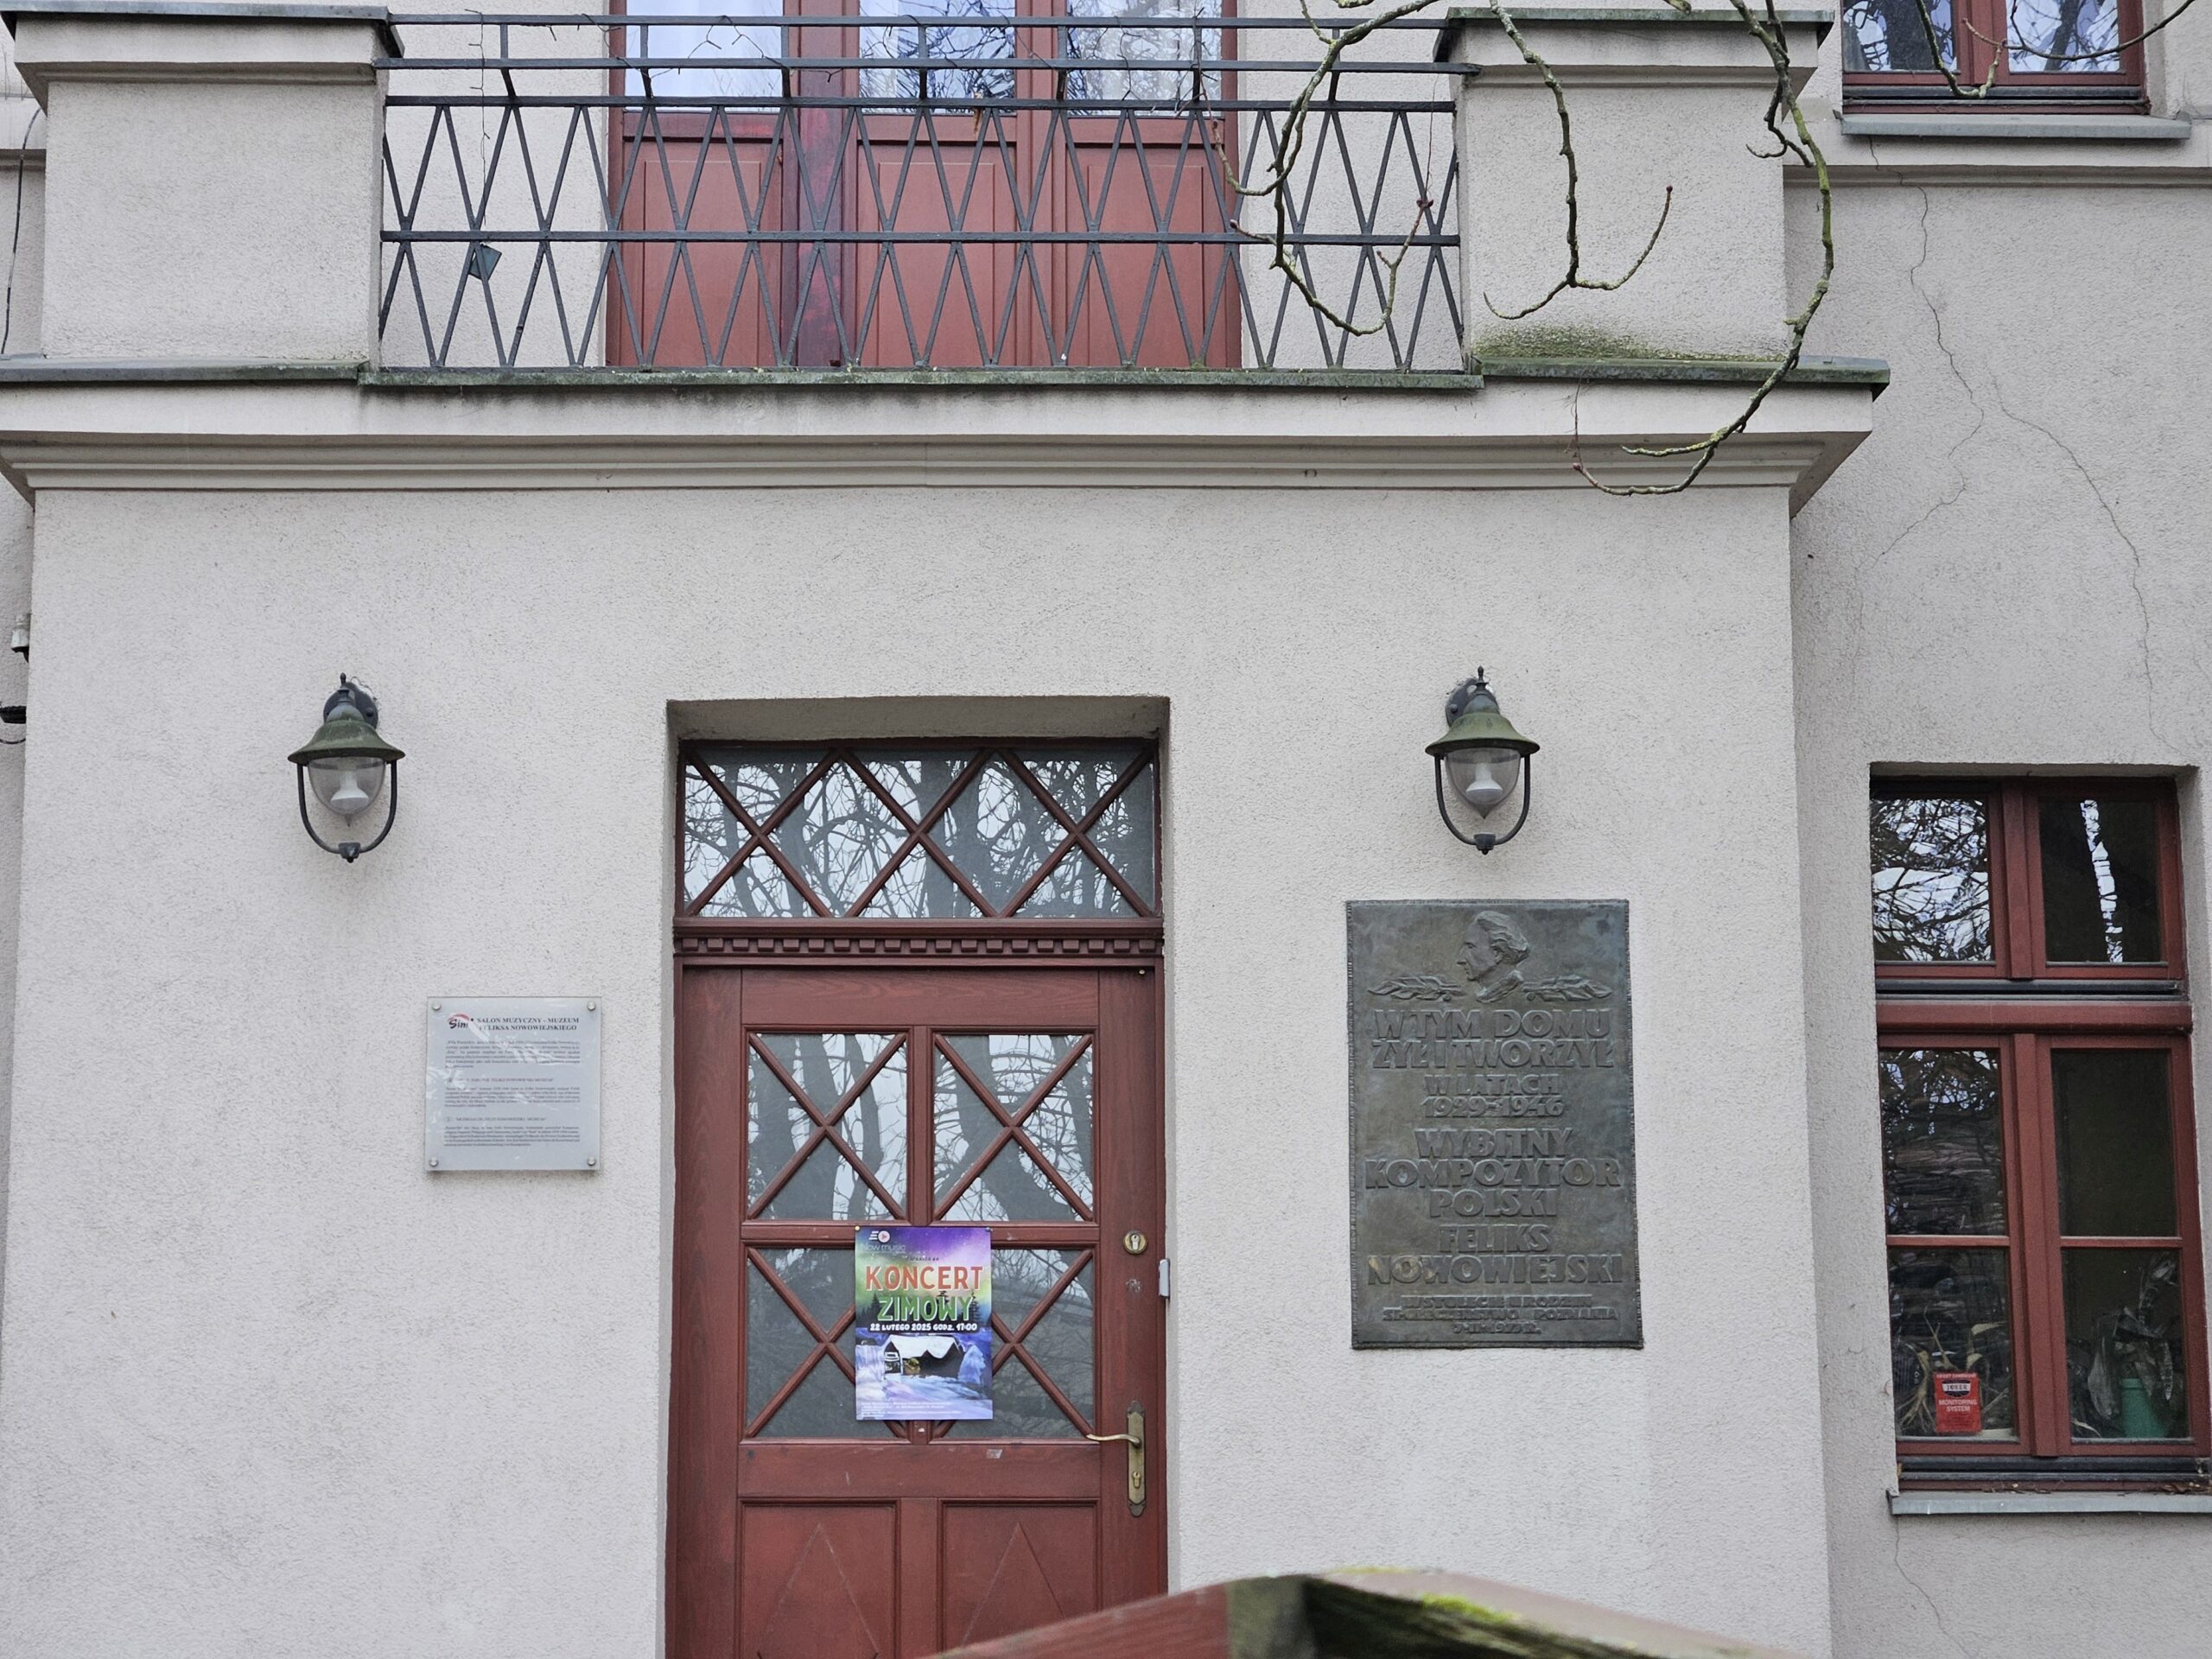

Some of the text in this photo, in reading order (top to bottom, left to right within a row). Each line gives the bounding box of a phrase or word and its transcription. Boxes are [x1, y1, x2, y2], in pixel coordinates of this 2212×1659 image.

[1374, 1009, 1611, 1039] W TYM DOMU
[1433, 1040, 1446, 1069] I
[1452, 1039, 1614, 1069] TWORZYŁ
[1424, 1074, 1560, 1096] W LATACH
[1414, 1128, 1572, 1159] WYBITNY
[1365, 1158, 1622, 1189] KOMPOZYTOR
[1431, 1188, 1559, 1217] POLSKI
[1439, 1224, 1553, 1254] FELIKS
[865, 1265, 982, 1291] KONCERT
[1367, 1254, 1623, 1285] NOWOWIEJSKI
[877, 1295, 975, 1322] ZIMOWY
[869, 1323, 880, 1332] 22
[912, 1323, 931, 1332] 2025
